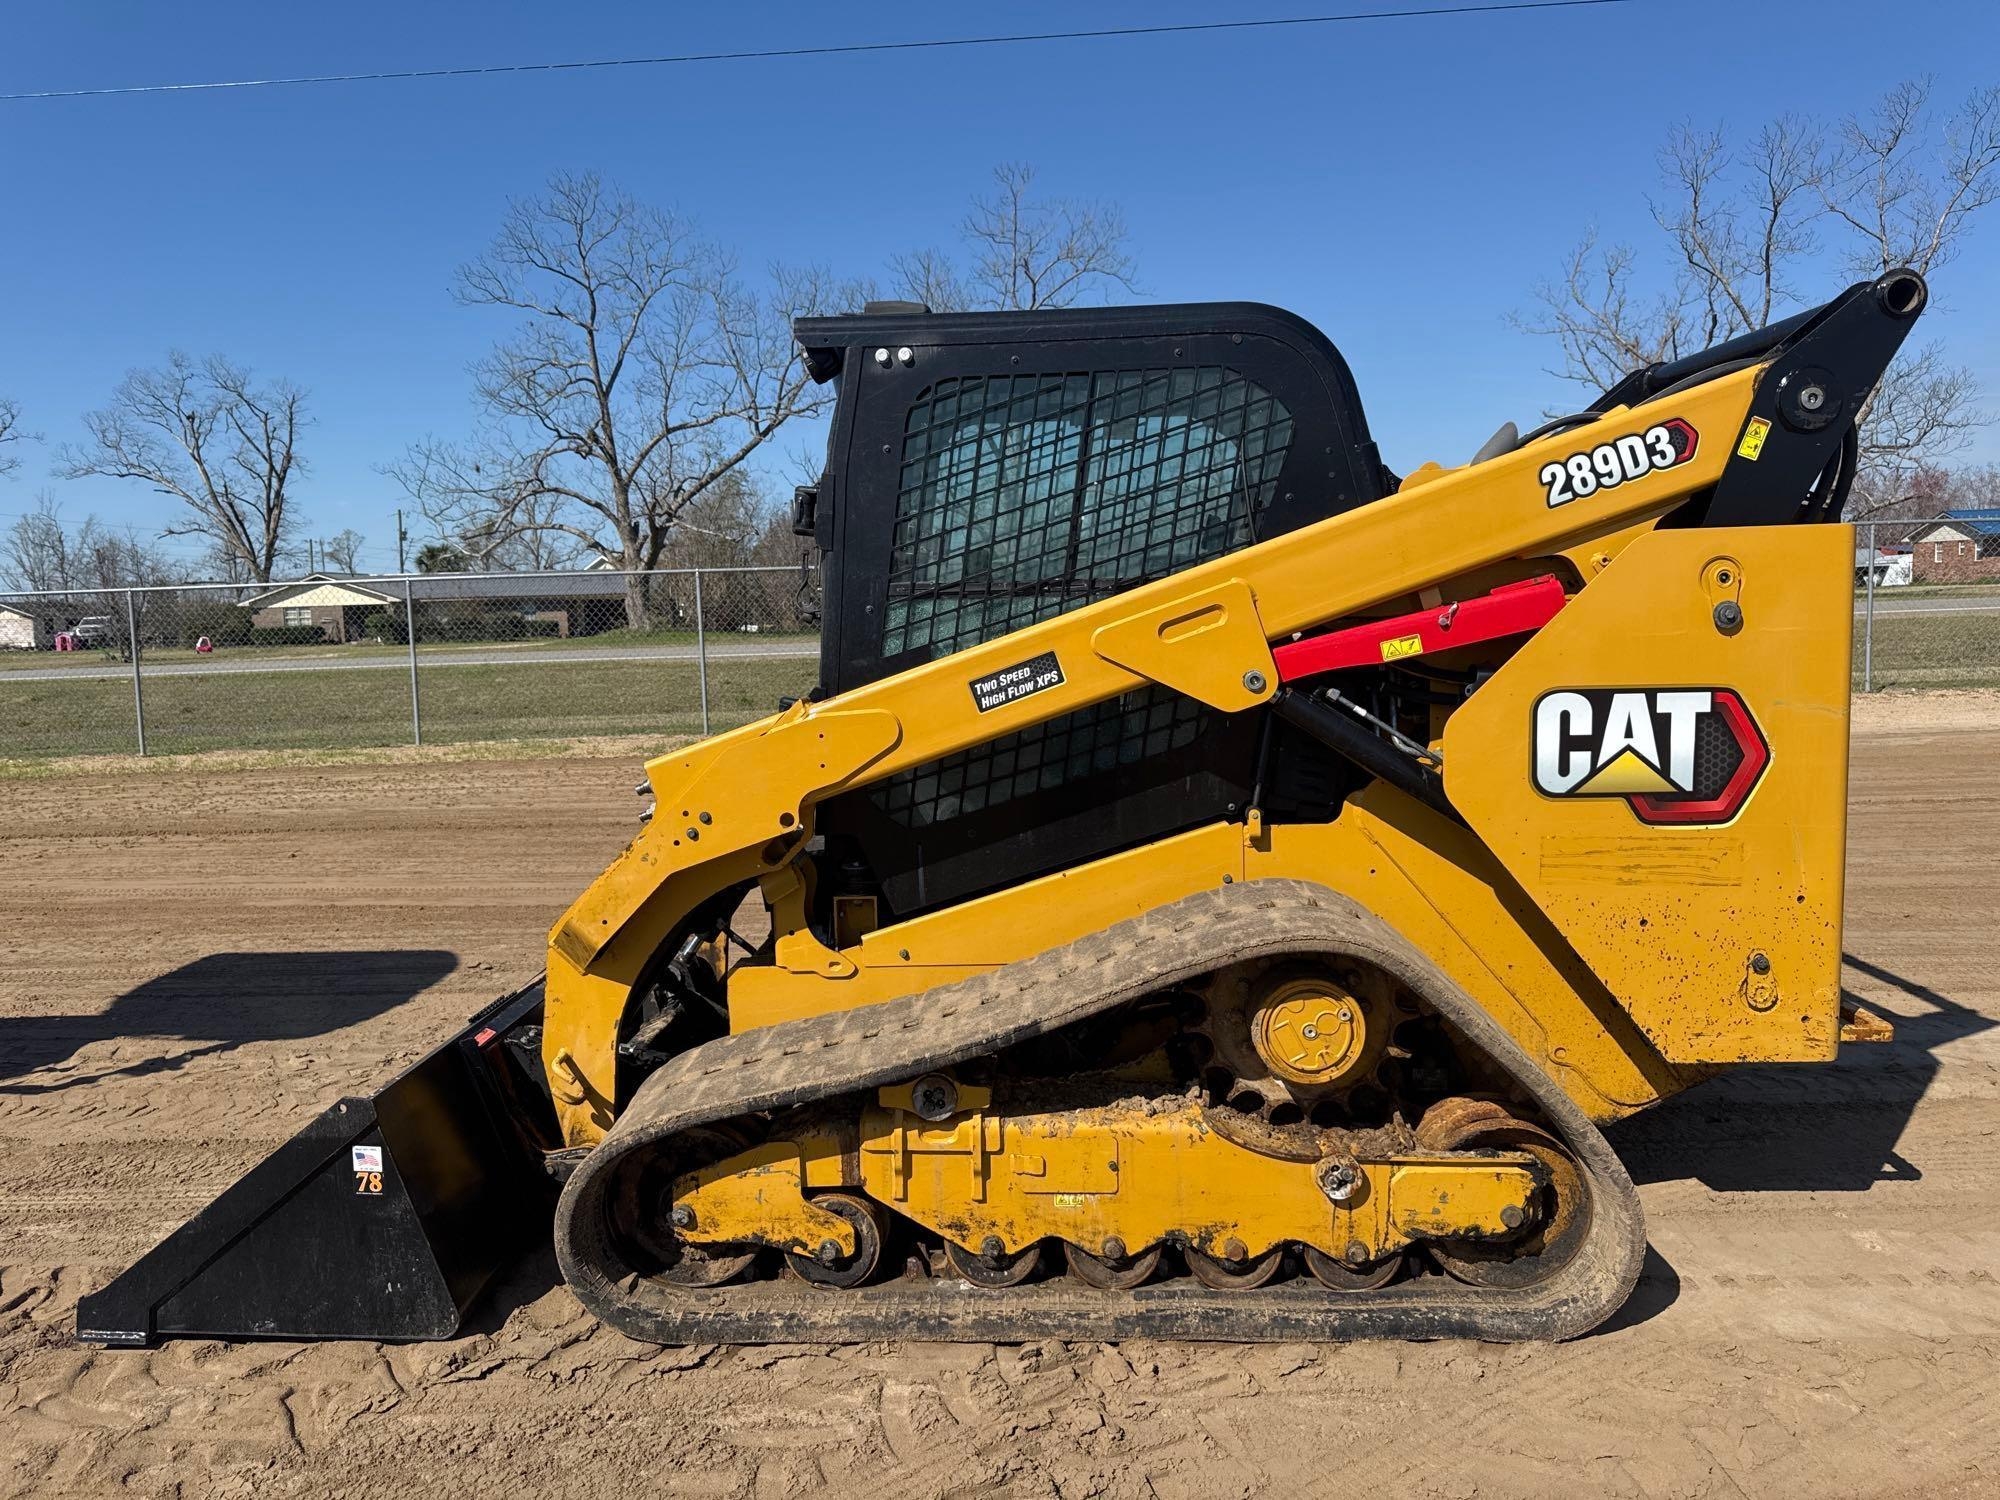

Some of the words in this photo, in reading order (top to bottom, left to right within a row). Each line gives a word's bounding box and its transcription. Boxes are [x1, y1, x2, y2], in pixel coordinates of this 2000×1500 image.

[1541, 426, 1677, 507] 289D3
[1036, 670, 1059, 688] XPS
[1536, 692, 1712, 793] CAT
[356, 1172, 382, 1192] 78
